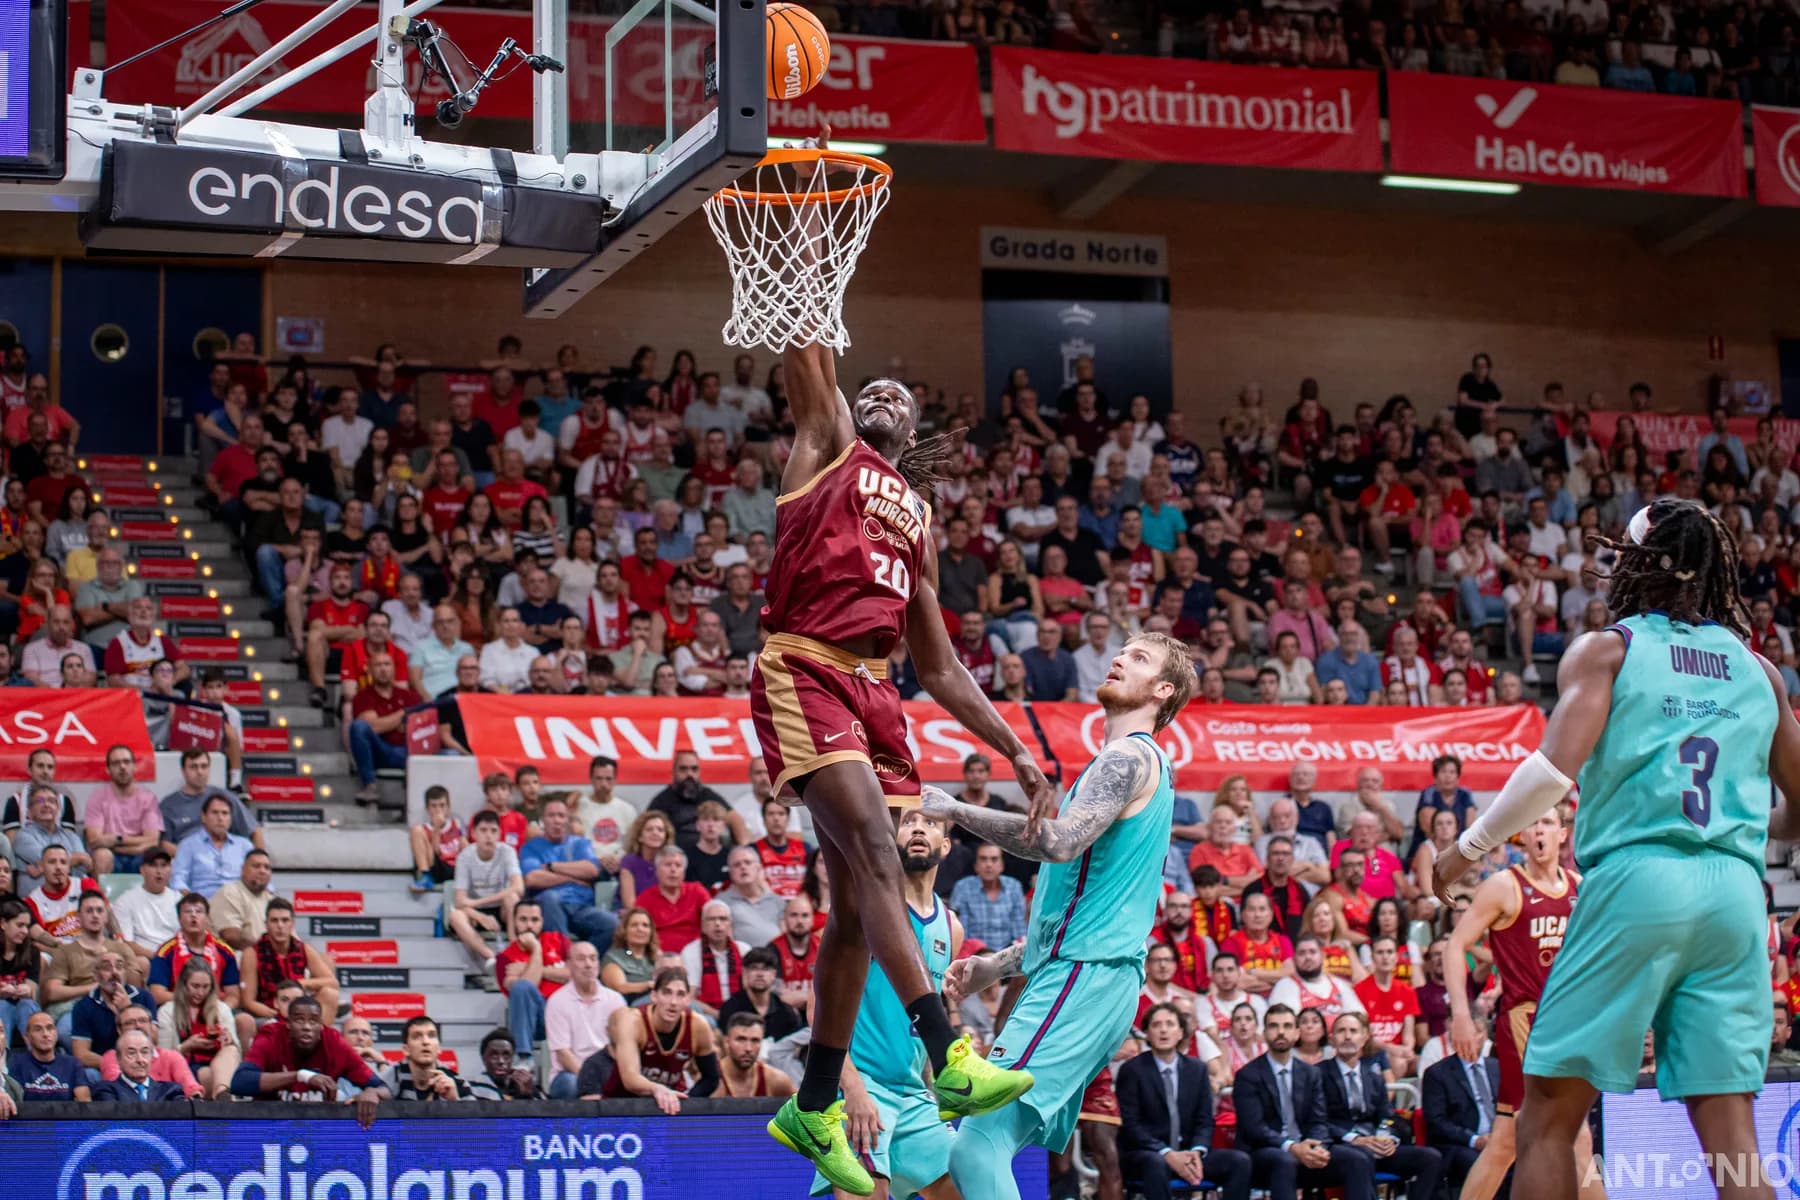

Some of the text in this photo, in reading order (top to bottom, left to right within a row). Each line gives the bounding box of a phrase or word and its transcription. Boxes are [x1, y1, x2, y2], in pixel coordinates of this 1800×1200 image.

[784, 43, 802, 99] Wilson
[768, 102, 890, 129] Helvetia
[1475, 135, 1669, 185] Halcón viajes
[188, 166, 484, 245] endesa
[989, 235, 1158, 265] Grada Norte
[858, 467, 919, 522] UCA
[864, 495, 921, 545] MURCIA
[869, 551, 910, 602] 20
[1669, 644, 1733, 682] UMUDE
[873, 762, 908, 777] Juver
[1213, 736, 1534, 762] REGIÓN DE MURCIA
[1678, 736, 1720, 829] 3
[1530, 915, 1568, 939] UCA
[82, 1143, 643, 1200] mediolanum
[524, 1134, 643, 1160] BANCO
